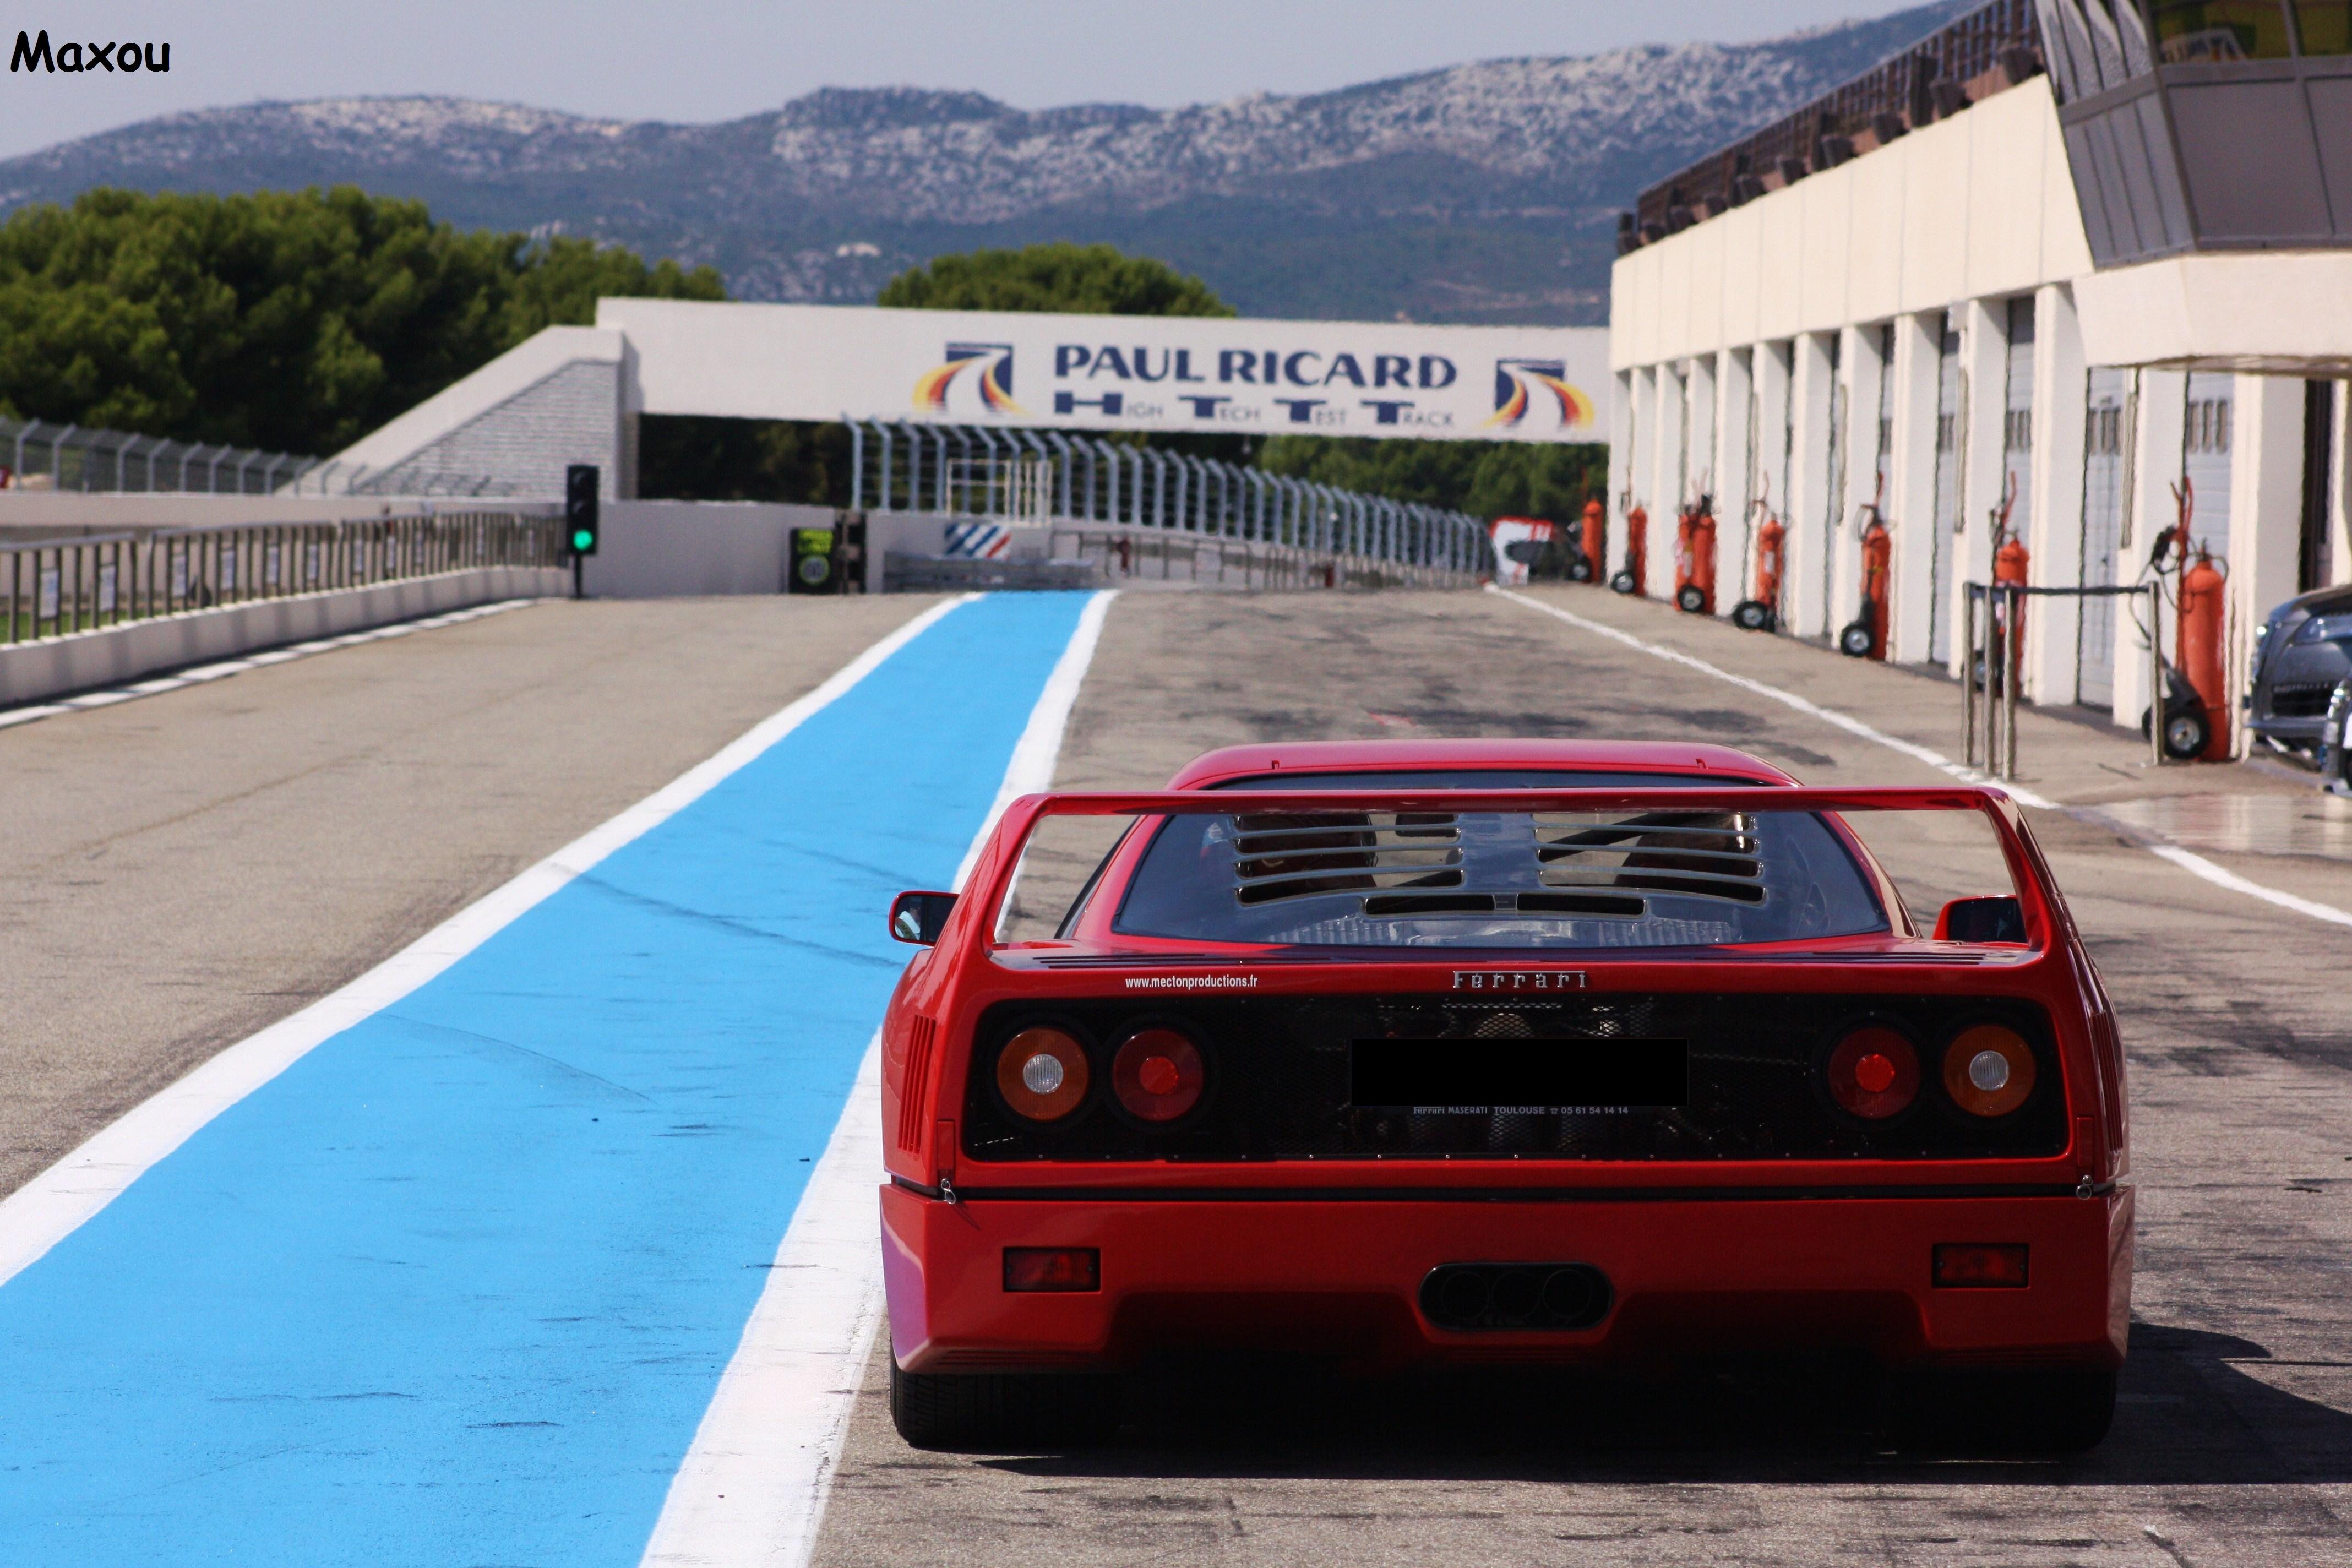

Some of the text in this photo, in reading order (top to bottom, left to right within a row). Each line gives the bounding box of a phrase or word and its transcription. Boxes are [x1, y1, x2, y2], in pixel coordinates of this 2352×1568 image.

[1055, 345, 1457, 389] PAUL RICARD
[1054, 391, 1454, 427] HIGH TECH TEST TRACK
[1125, 974, 1257, 990] www.mectonproductions.fr
[1453, 971, 1586, 988] Ferrari
[1413, 1106, 1445, 1114] Ferrari
